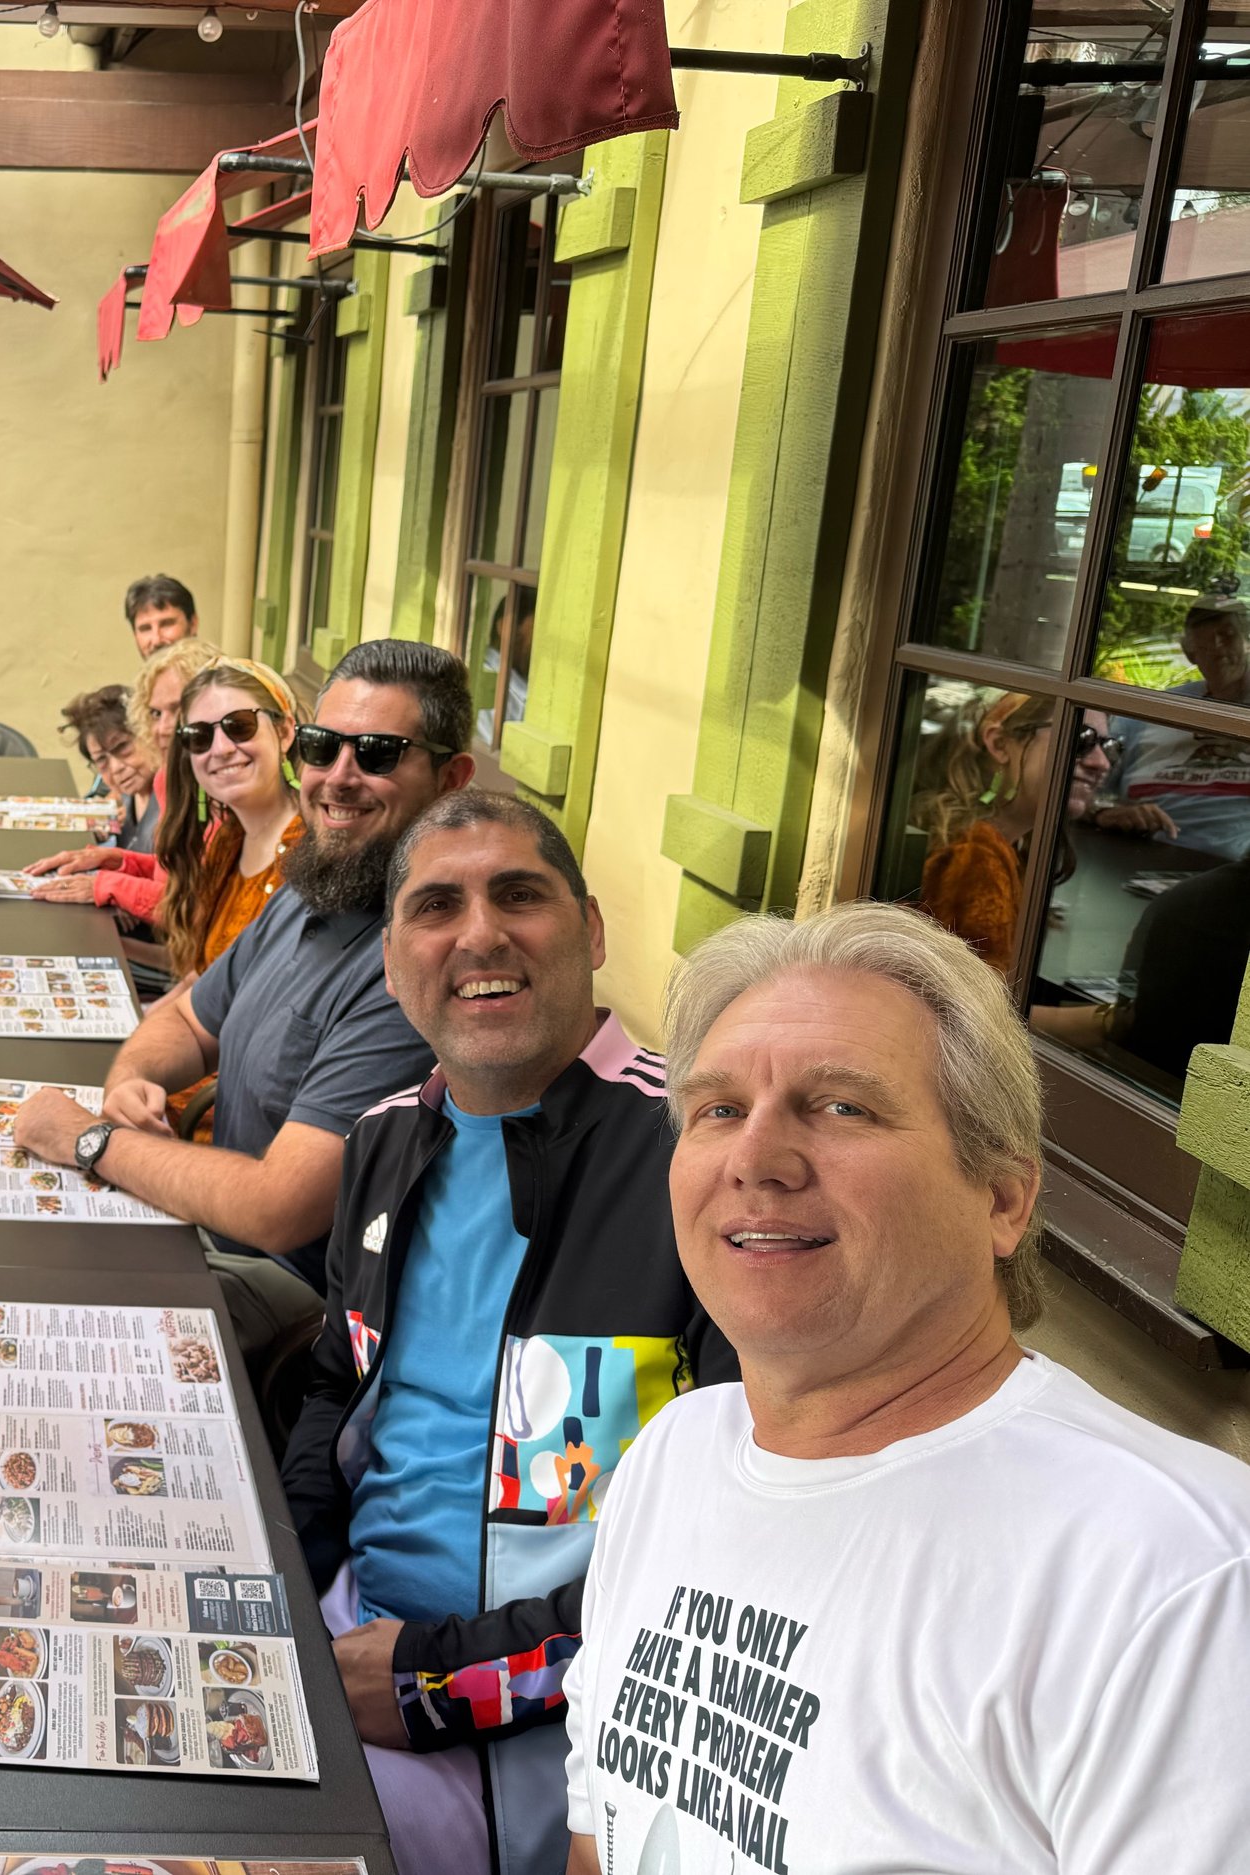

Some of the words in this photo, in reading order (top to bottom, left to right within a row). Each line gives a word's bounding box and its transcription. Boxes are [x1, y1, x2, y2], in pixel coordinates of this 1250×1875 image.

[163, 1310, 176, 1337] MUFFINS
[626, 1628, 683, 1687] HAVE
[682, 1645, 702, 1697] A
[709, 1653, 821, 1750] HAMMER
[664, 1585, 686, 1630] IF
[685, 1588, 733, 1646] YOU
[737, 1605, 809, 1672] ONLY
[597, 1722, 672, 1800] LOOKS
[676, 1759, 722, 1832] LIKE
[719, 1784, 733, 1843] A
[738, 1793, 789, 1874] NAIL
[612, 1676, 688, 1747] EVERY
[692, 1705, 793, 1806] PROBLEM
